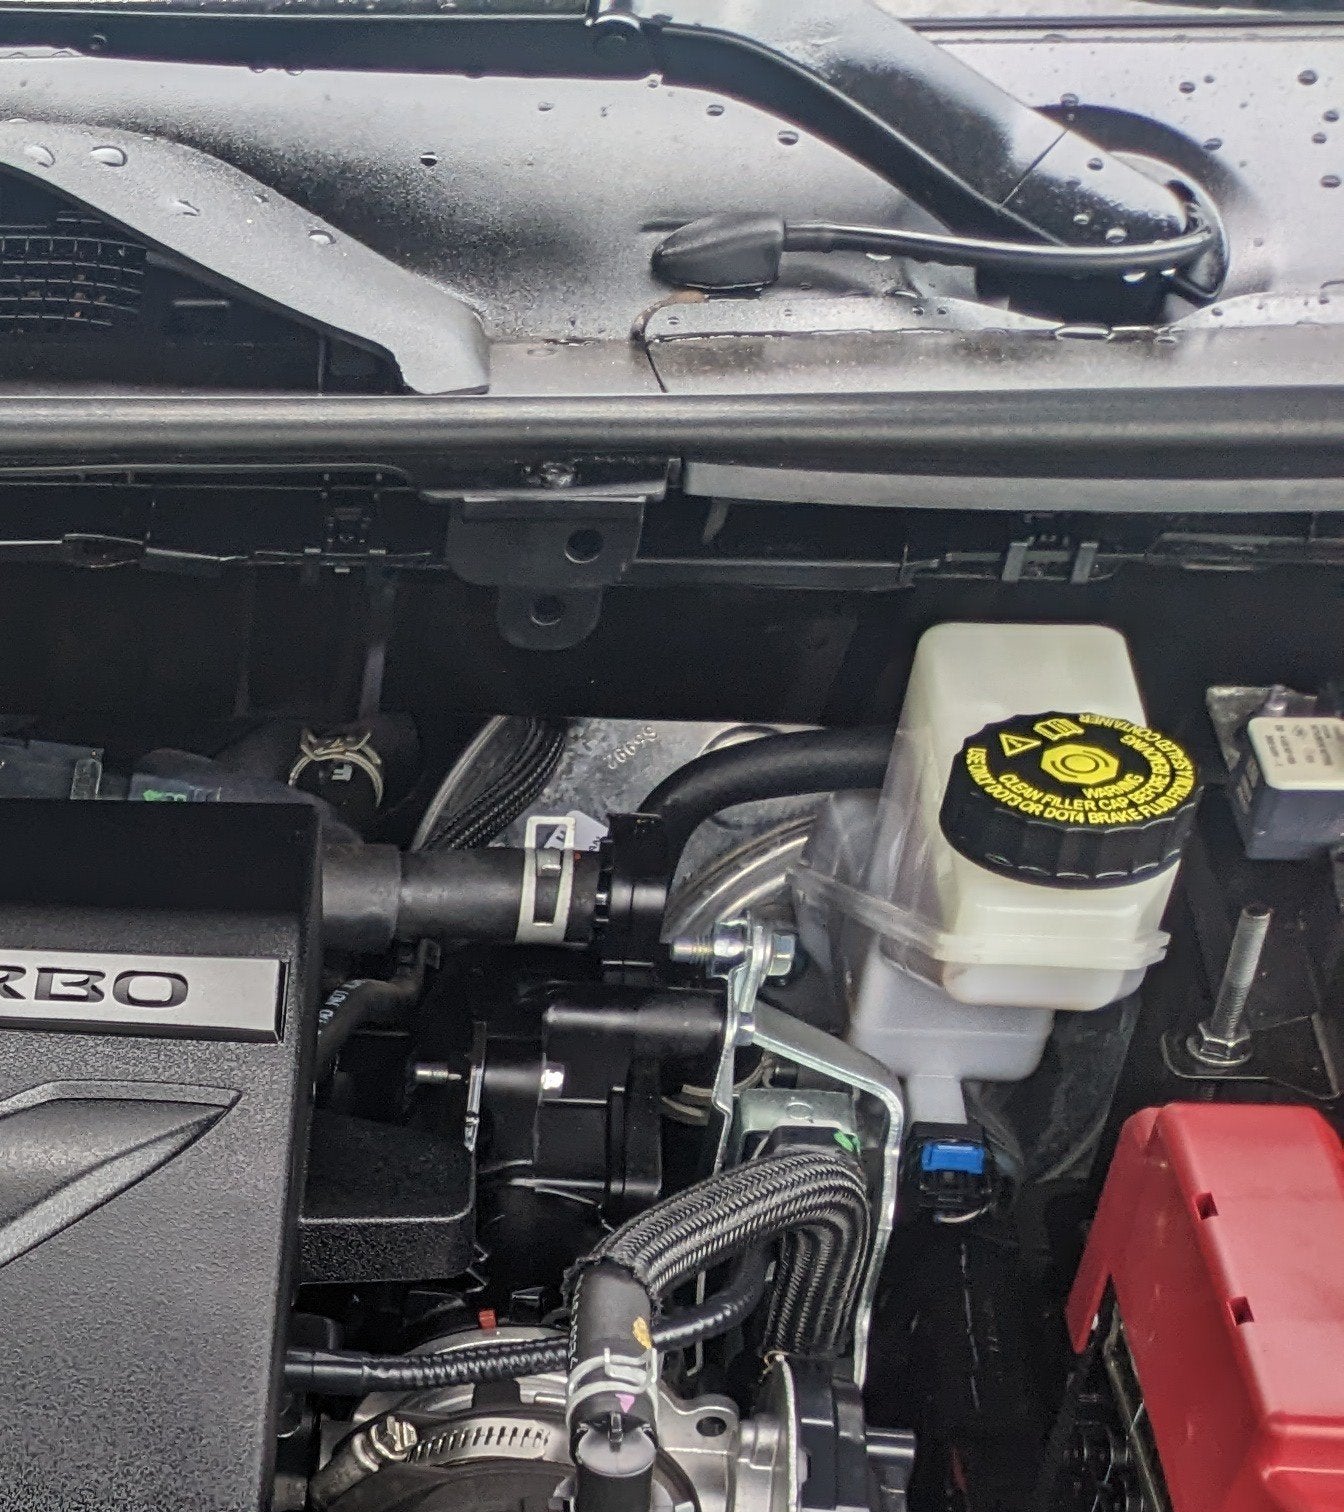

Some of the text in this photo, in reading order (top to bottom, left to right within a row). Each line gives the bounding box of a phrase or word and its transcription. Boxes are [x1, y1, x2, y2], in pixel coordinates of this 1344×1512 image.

[1079, 712, 1163, 742] CONTAINER
[966, 747, 988, 765] USE
[967, 763, 995, 786] ONLY
[999, 734, 1171, 812] CLEAN FILLER CAP BEFORE REMOVING
[984, 782, 1019, 806] DOT3
[1082, 773, 1144, 799] WARNING
[1167, 776, 1194, 802] FROM
[1018, 801, 1043, 816] OR
[1042, 806, 1086, 824] DOT4
[1087, 808, 1144, 824] BRAKE
[1138, 794, 1178, 819] FLUID
